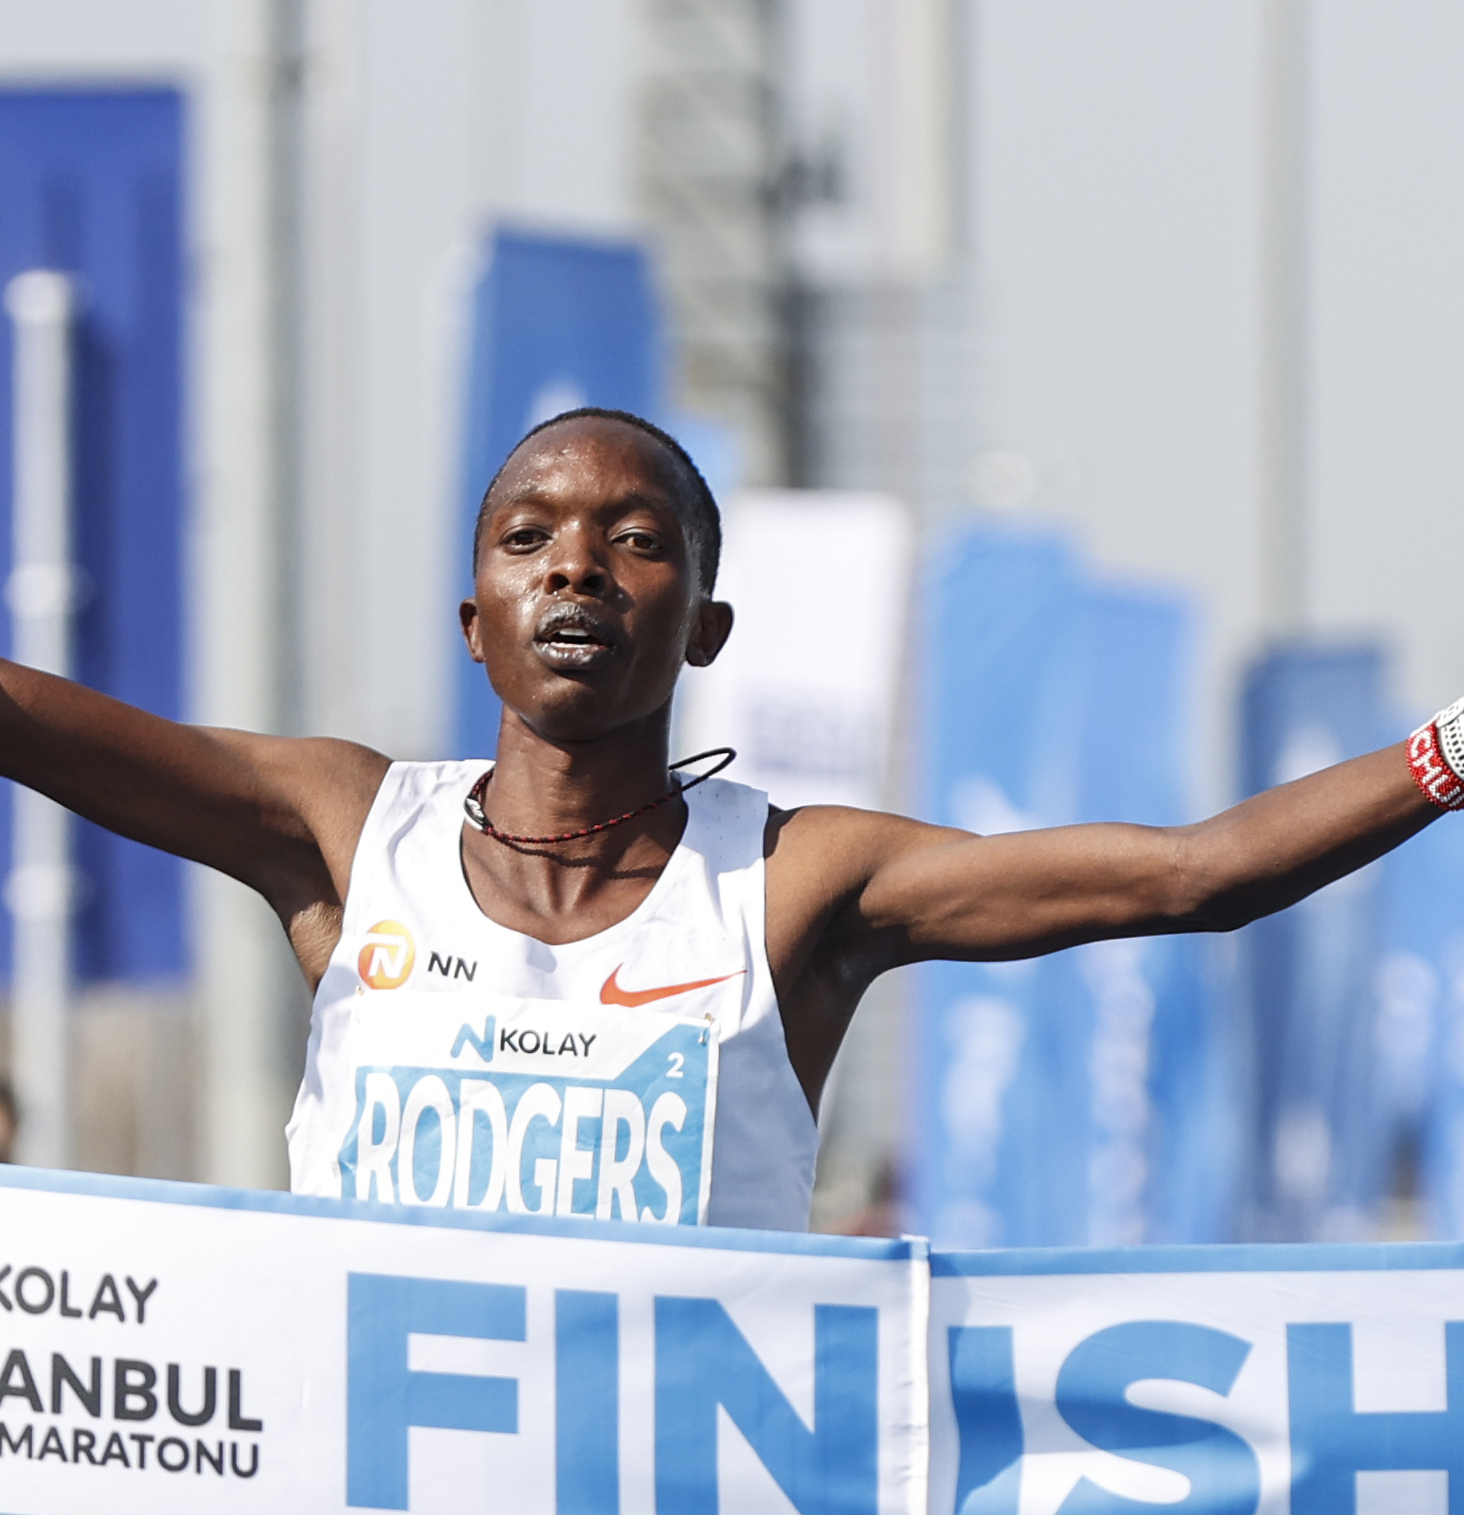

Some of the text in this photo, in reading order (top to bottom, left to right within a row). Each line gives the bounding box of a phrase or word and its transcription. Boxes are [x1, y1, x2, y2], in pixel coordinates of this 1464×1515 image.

[427, 951, 478, 982] NN
[499, 1028, 597, 1057] KOLAY
[666, 1053, 685, 1078] 2
[355, 1072, 688, 1225] RODGERS
